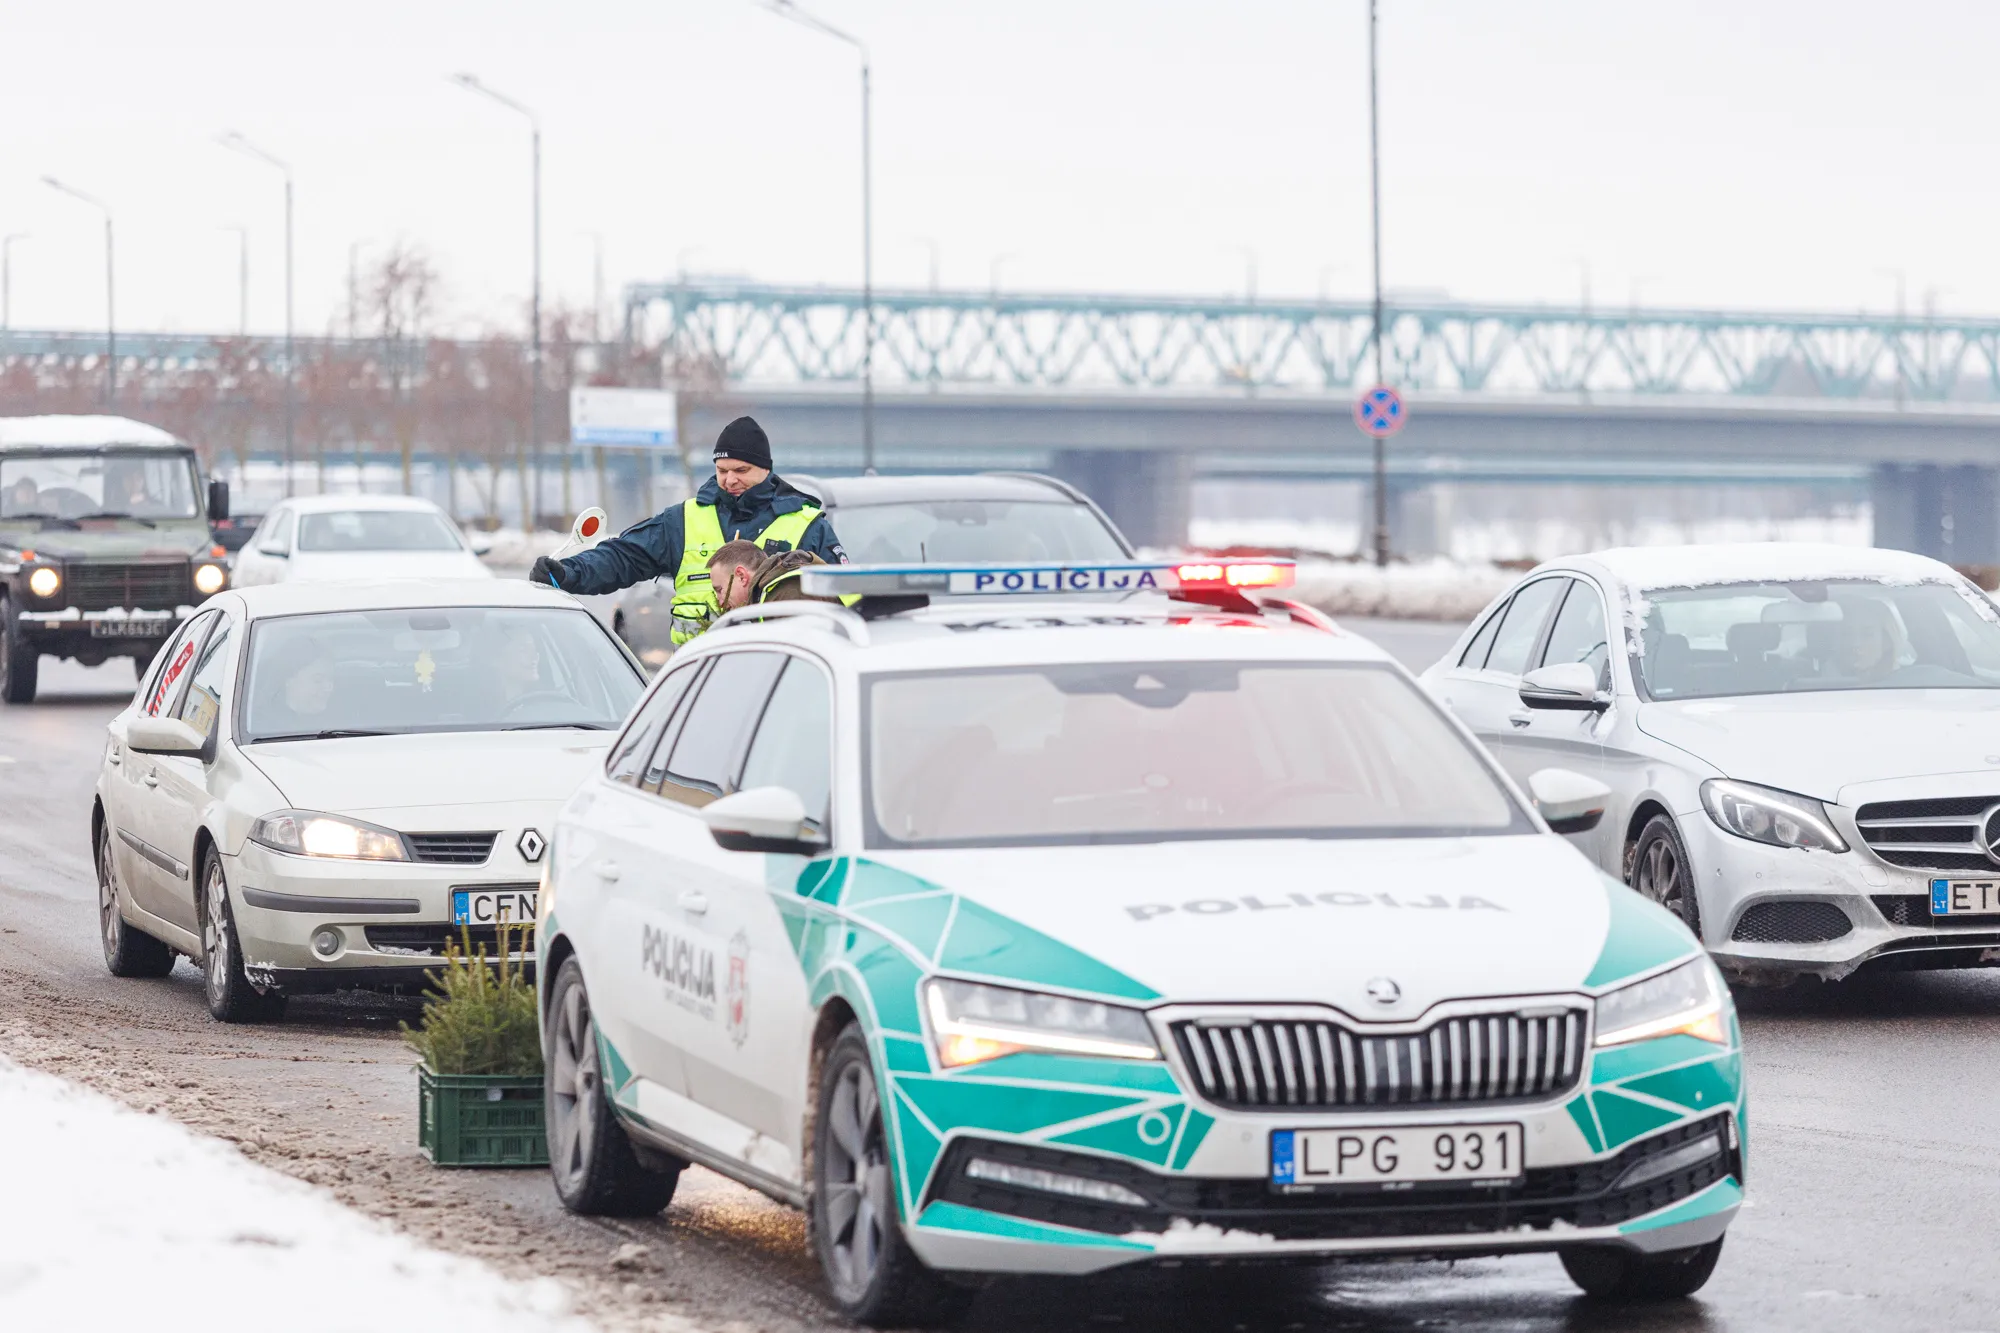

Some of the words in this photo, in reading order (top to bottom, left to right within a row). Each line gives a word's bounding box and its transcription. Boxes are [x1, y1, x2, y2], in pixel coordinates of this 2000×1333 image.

[975, 571, 1157, 590] POLICIJA
[1124, 891, 1513, 922] POLICIJA
[1934, 901, 1947, 909] LT
[1952, 884, 2000, 910] ET
[643, 923, 716, 1004] POLICIJA
[1274, 1161, 1294, 1177] LT
[1304, 1136, 1398, 1176] LPG
[1434, 1131, 1508, 1173] 931
